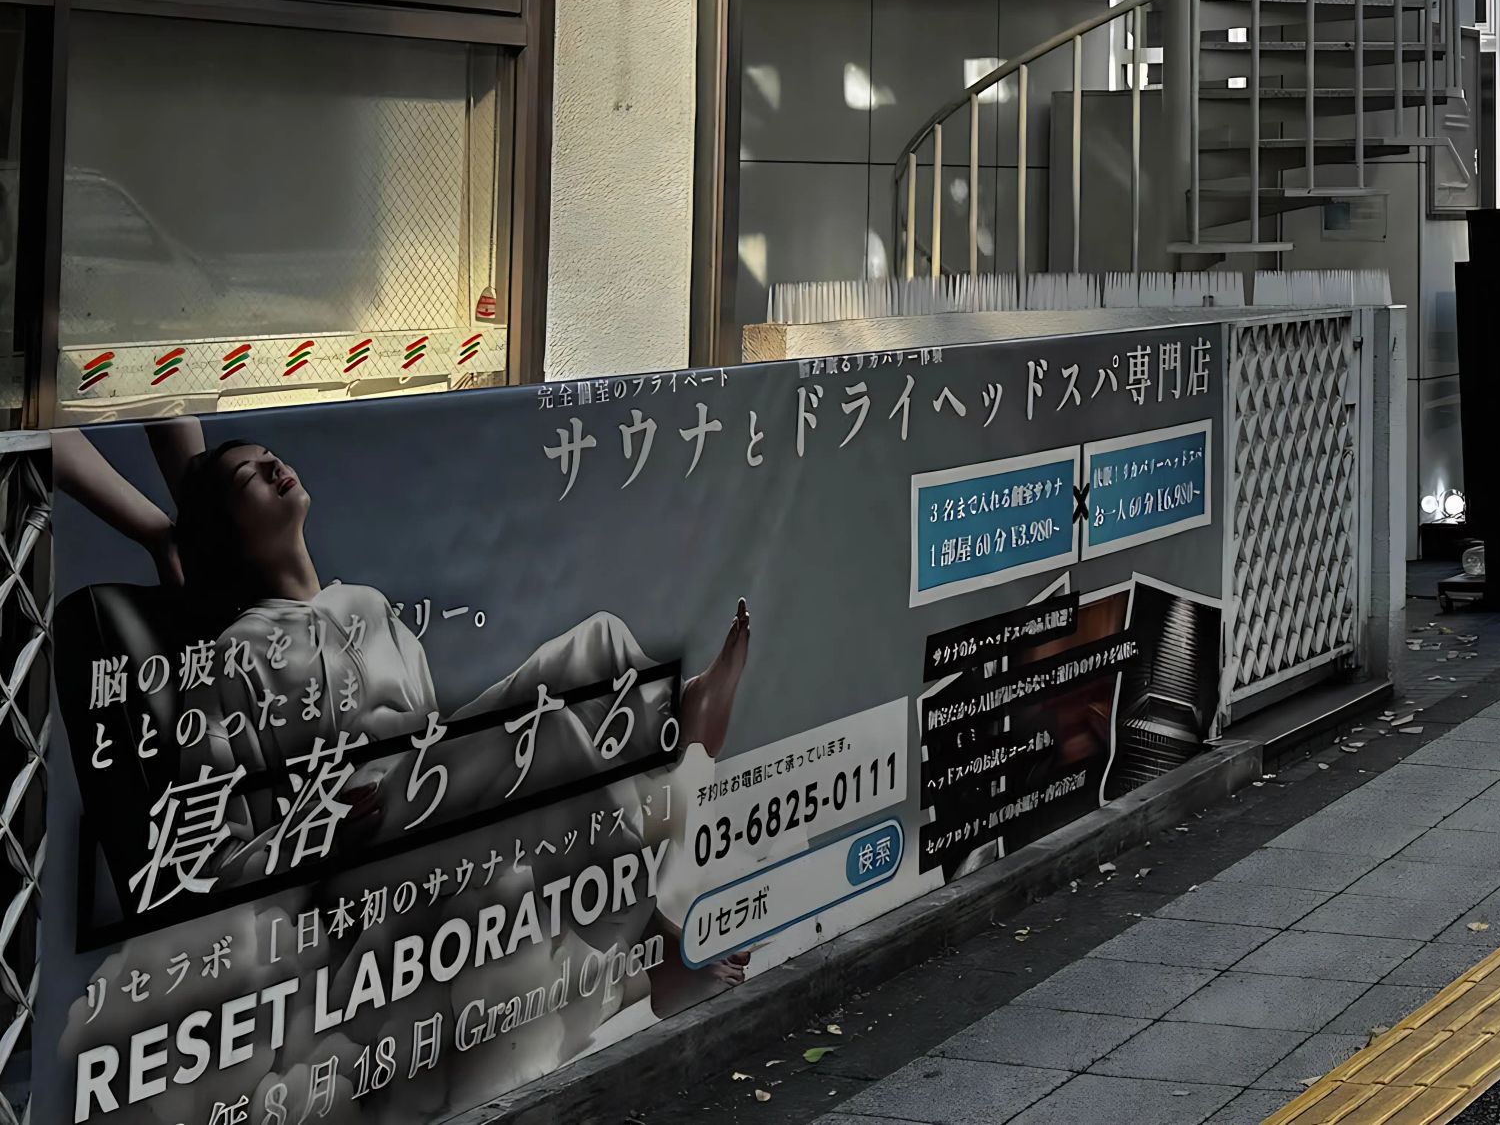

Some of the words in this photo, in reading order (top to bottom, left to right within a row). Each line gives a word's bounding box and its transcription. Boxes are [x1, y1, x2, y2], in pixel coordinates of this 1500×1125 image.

[544, 337, 1212, 502] サウナとドライヘッドスパ専門店
[91, 674, 359, 769] ととのったまま
[128, 667, 680, 915] 寝落ちする。
[694, 752, 896, 867] 03-6825-0111
[858, 836, 892, 875] 検索
[698, 885, 770, 946] リセラボ
[74, 977, 300, 1124] RESET
[314, 838, 671, 1034] LABORATORY
[86, 935, 234, 1024] リセラボ
[455, 956, 572, 1053] Grand
[578, 933, 665, 1006] Open
